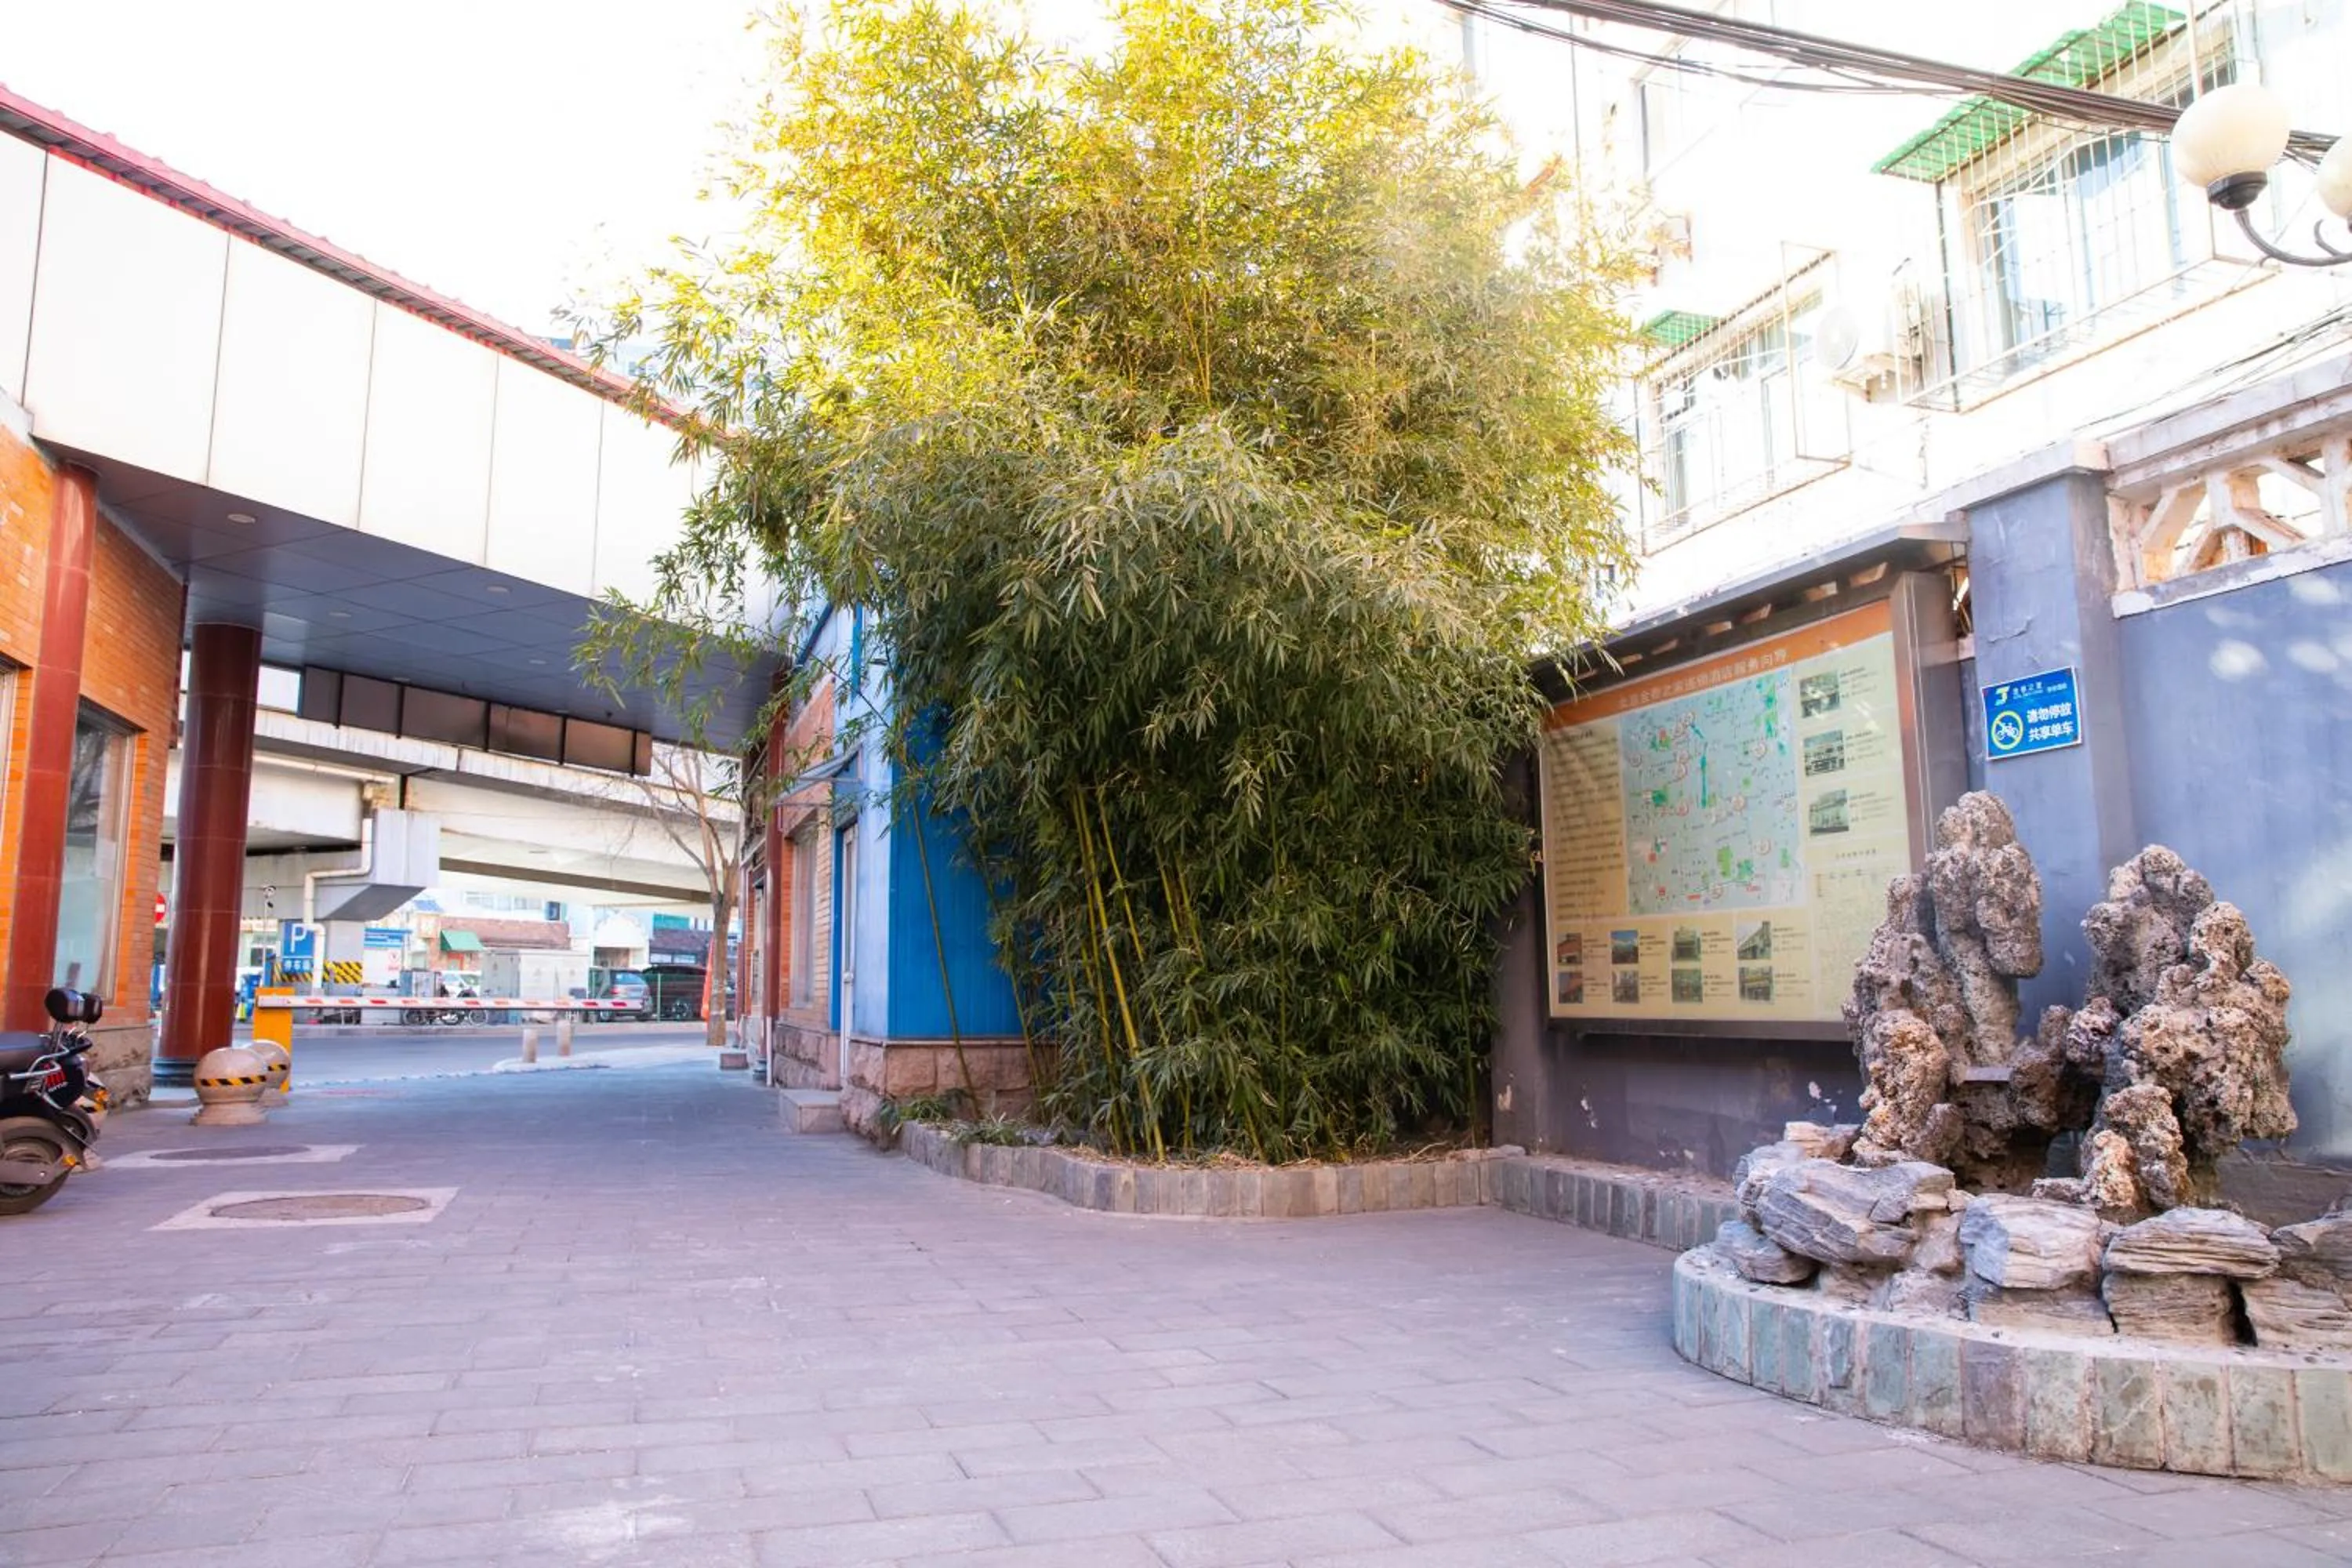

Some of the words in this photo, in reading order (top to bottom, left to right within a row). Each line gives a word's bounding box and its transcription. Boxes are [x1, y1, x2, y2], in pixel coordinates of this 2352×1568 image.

[2027, 702, 2072, 724] 请勿停放
[2028, 720, 2074, 742] 共享单车
[290, 924, 307, 953] P
